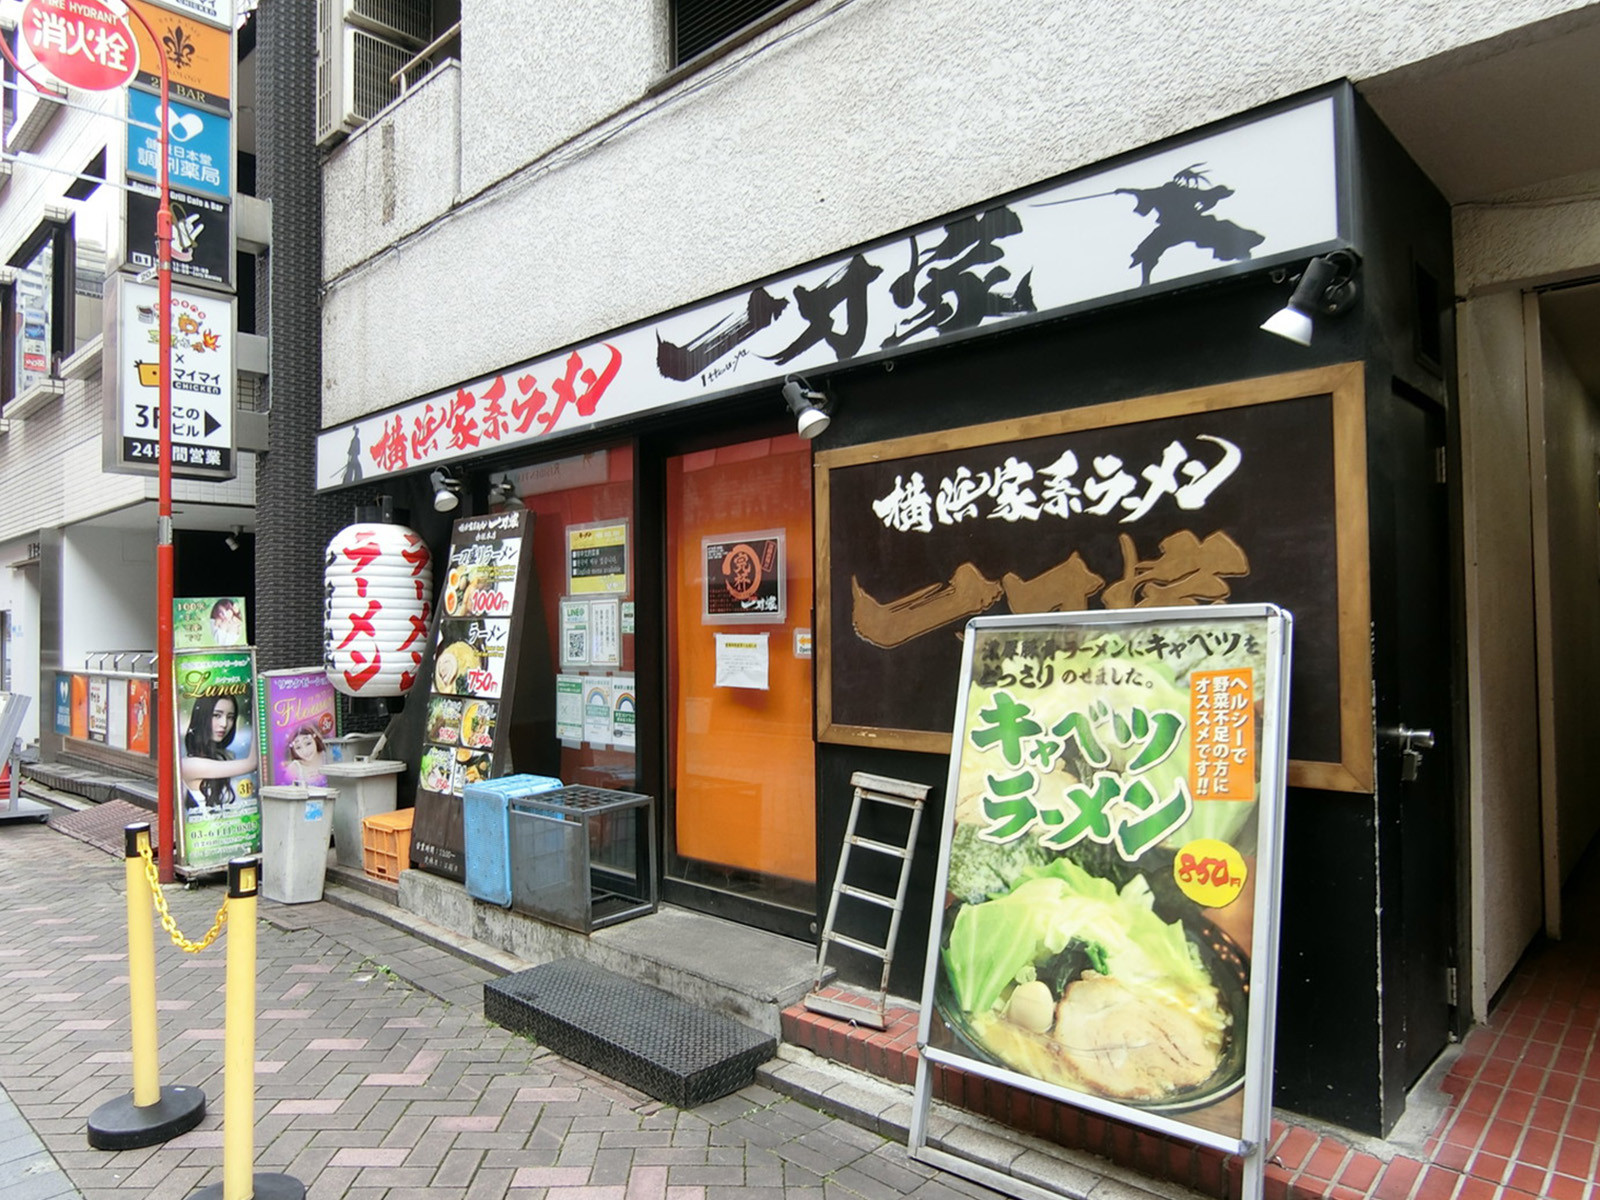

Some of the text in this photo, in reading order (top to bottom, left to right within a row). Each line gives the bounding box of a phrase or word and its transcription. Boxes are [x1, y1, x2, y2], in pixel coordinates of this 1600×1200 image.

[32, 8, 129, 72] 消火栓
[69, 2, 119, 26] HYDRANT
[176, 84, 206, 103] BAR
[174, 368, 221, 386] マイマイ
[370, 342, 622, 472] 横浜家系ラーメン
[172, 406, 200, 420] この
[173, 423, 200, 437] ビル
[873, 433, 1242, 533] 横浜家系ラーメン
[336, 532, 383, 692] ラーメン
[469, 622, 507, 643] ラーメン
[468, 669, 498, 693] 750円
[971, 692, 1182, 774] キャベツ
[1212, 675, 1230, 794] 野菜不足の方に
[1230, 675, 1249, 764] ヘルシーで
[980, 771, 1190, 858] ラーメン
